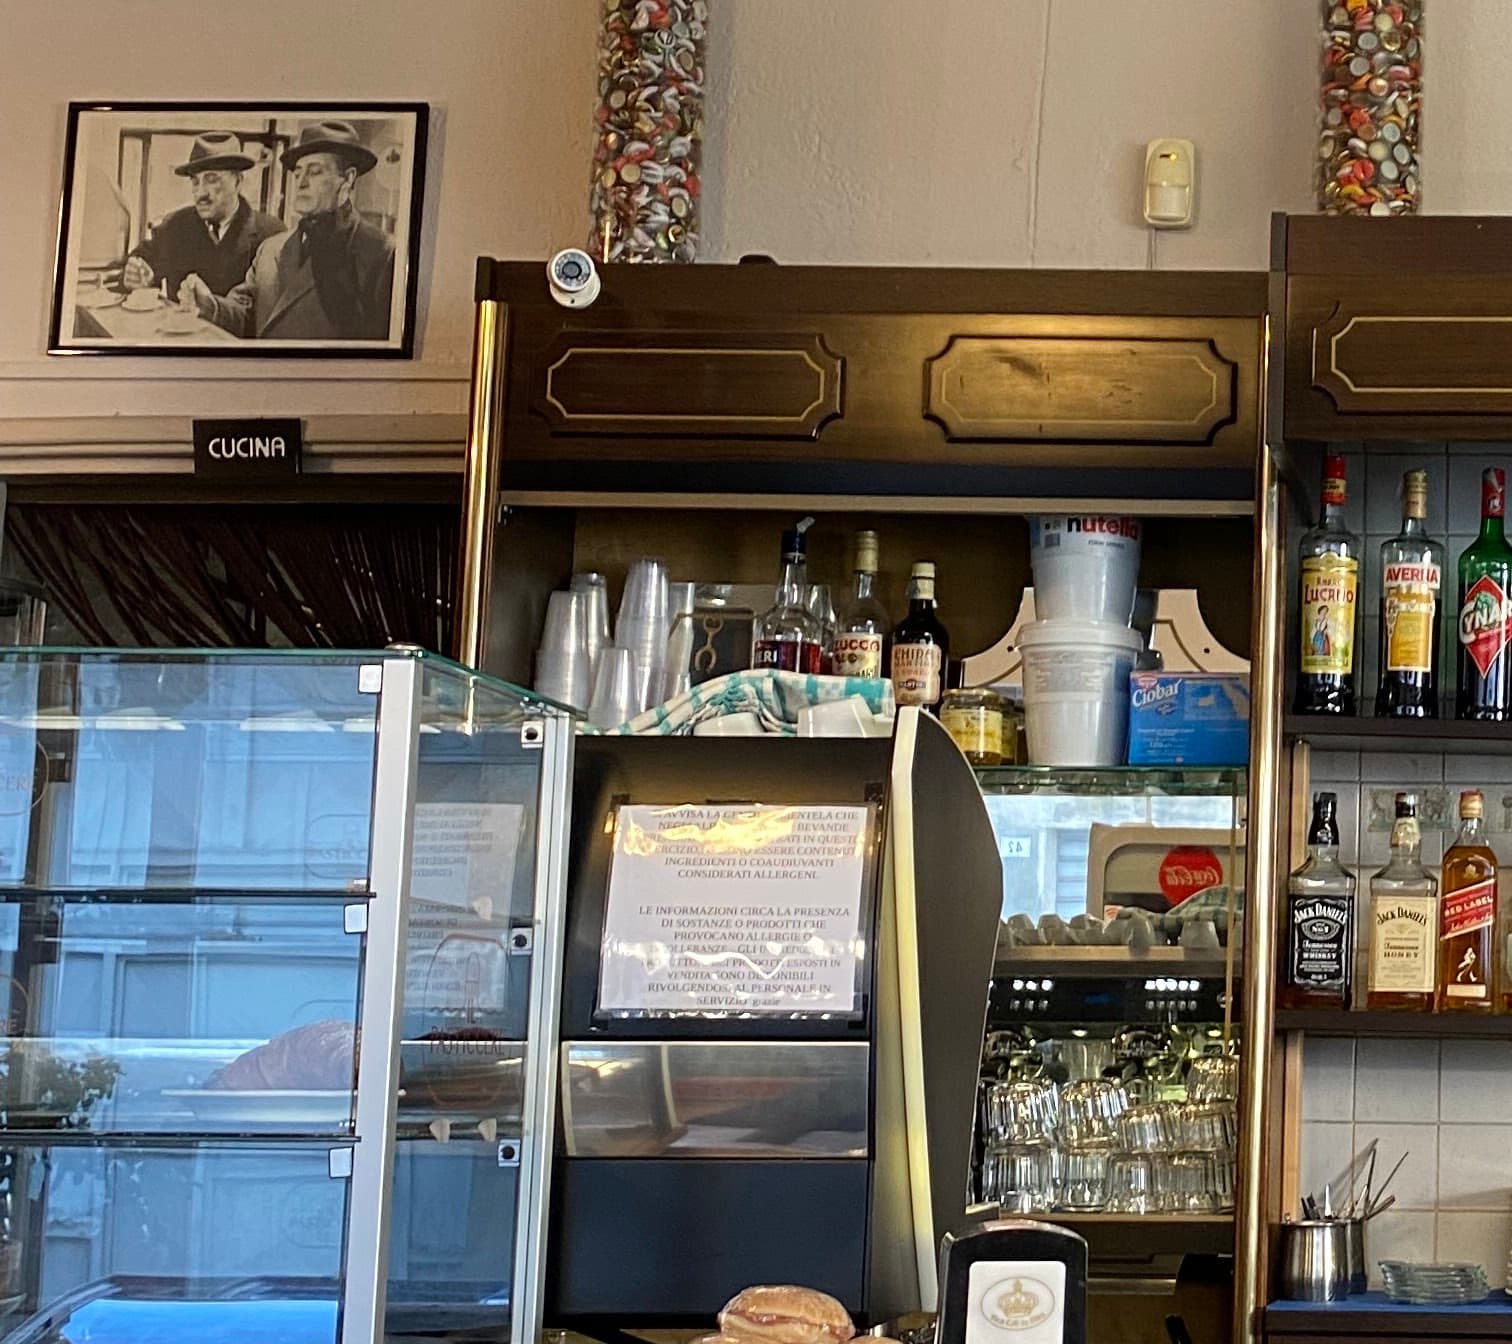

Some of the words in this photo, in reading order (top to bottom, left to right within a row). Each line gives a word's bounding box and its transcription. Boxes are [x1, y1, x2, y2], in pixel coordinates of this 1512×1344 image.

[208, 436, 286, 460] CUCINA
[1066, 515, 1139, 540] nutella
[1132, 678, 1182, 708] Ciobar
[664, 857, 737, 867] INGREDIENTI
[677, 869, 752, 879] CONSIDERATI
[655, 906, 737, 916] INFORMAZIONI
[739, 906, 775, 916] CIRCA
[793, 907, 850, 917] PRESENZA
[1294, 905, 1315, 924] JACK
[1315, 902, 1347, 925] DANIEL'S
[1444, 904, 1463, 918] RED
[1464, 895, 1493, 911] LABEL
[674, 919, 733, 929] SOSTANZE
[746, 920, 802, 929] PRODOTTI
[1376, 910, 1395, 926] JACK
[1397, 907, 1428, 927] DANIEL'S
[674, 931, 744, 941] PROVOCANO
[745, 932, 801, 941] ALLERGIE
[751, 984, 819, 993] PERSONALE
